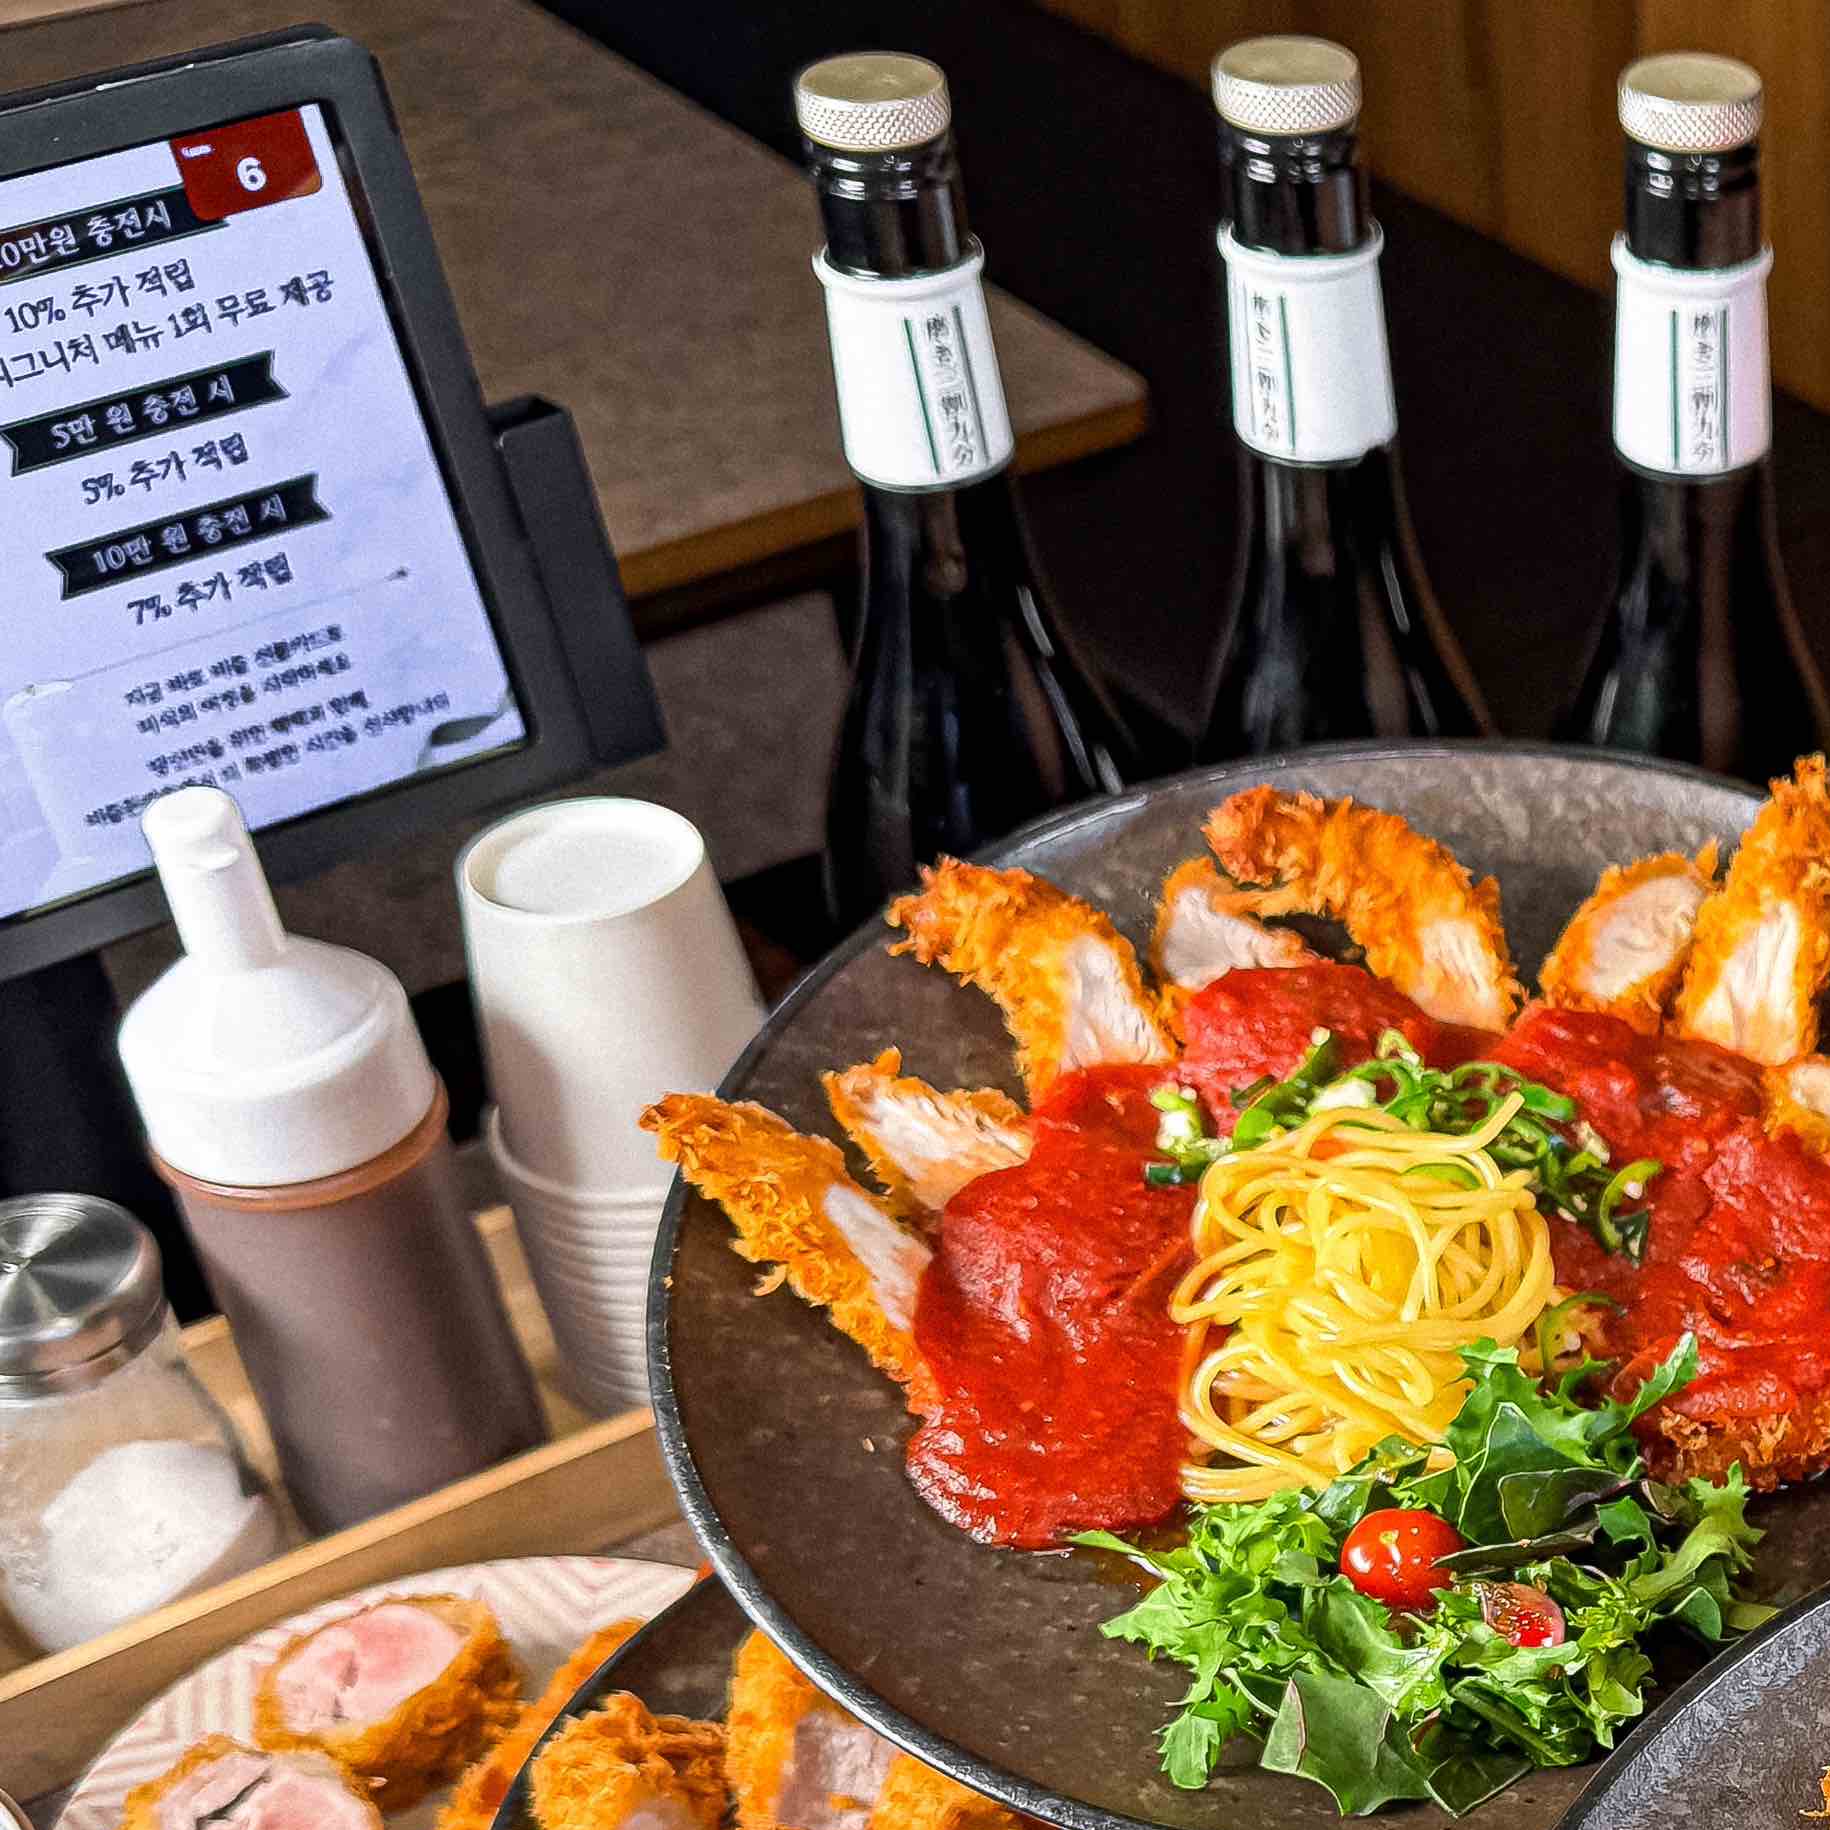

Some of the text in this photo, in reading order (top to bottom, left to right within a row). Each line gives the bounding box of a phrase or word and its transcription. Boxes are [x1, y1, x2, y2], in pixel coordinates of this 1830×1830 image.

[236, 156, 267, 192] 6
[0, 200, 172, 269] 0만원 충전시
[4, 258, 195, 333] 10% 추가 적립
[102, 321, 164, 353] 메뉴
[168, 303, 212, 338] 1회
[215, 288, 276, 326] 무료
[279, 270, 334, 306] 제공
[50, 374, 234, 448] 5만 원 충전 시
[81, 432, 249, 505] 5% 추가 적립
[93, 493, 287, 574] 10만 원 충전 시
[127, 552, 293, 625] 7% 추가 적립
